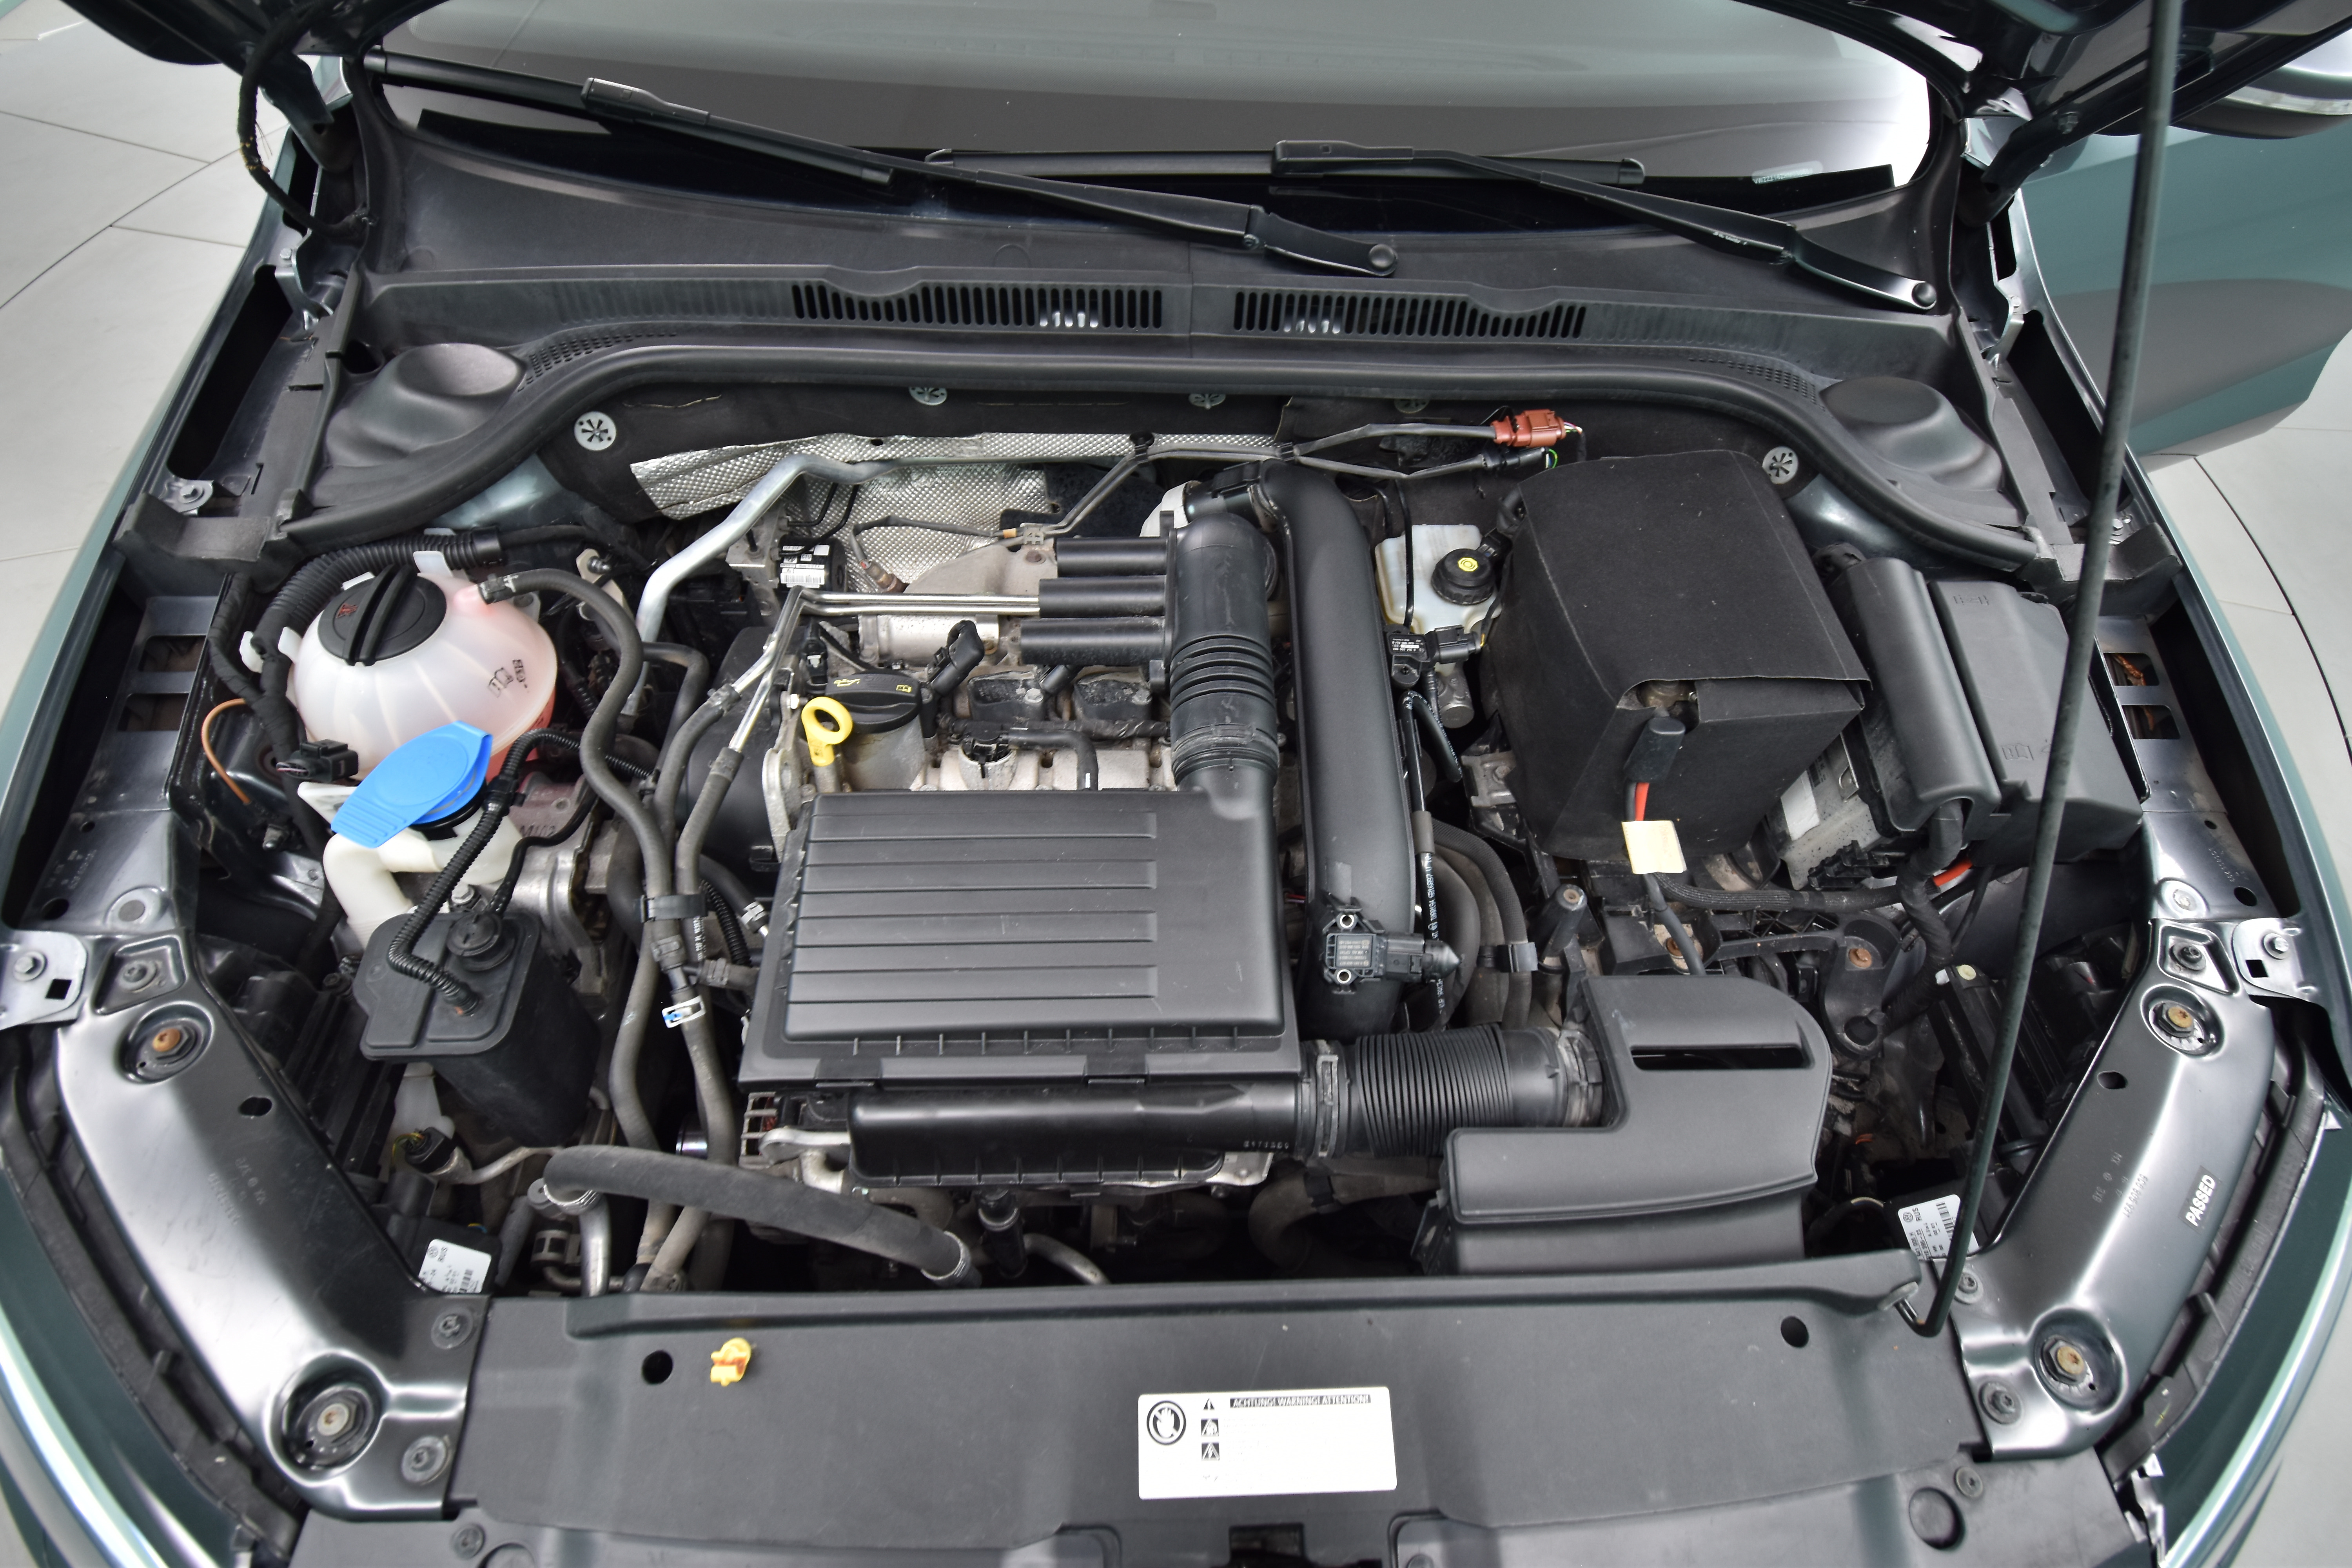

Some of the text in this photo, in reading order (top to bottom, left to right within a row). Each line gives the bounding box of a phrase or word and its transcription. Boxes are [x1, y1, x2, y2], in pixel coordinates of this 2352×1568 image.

[2185, 1174, 2216, 1227] PASSED
[1911, 1206, 1922, 1222] RUS
[1233, 1394, 1369, 1408] ACHTUNG! WARNING! ATTENTION!
